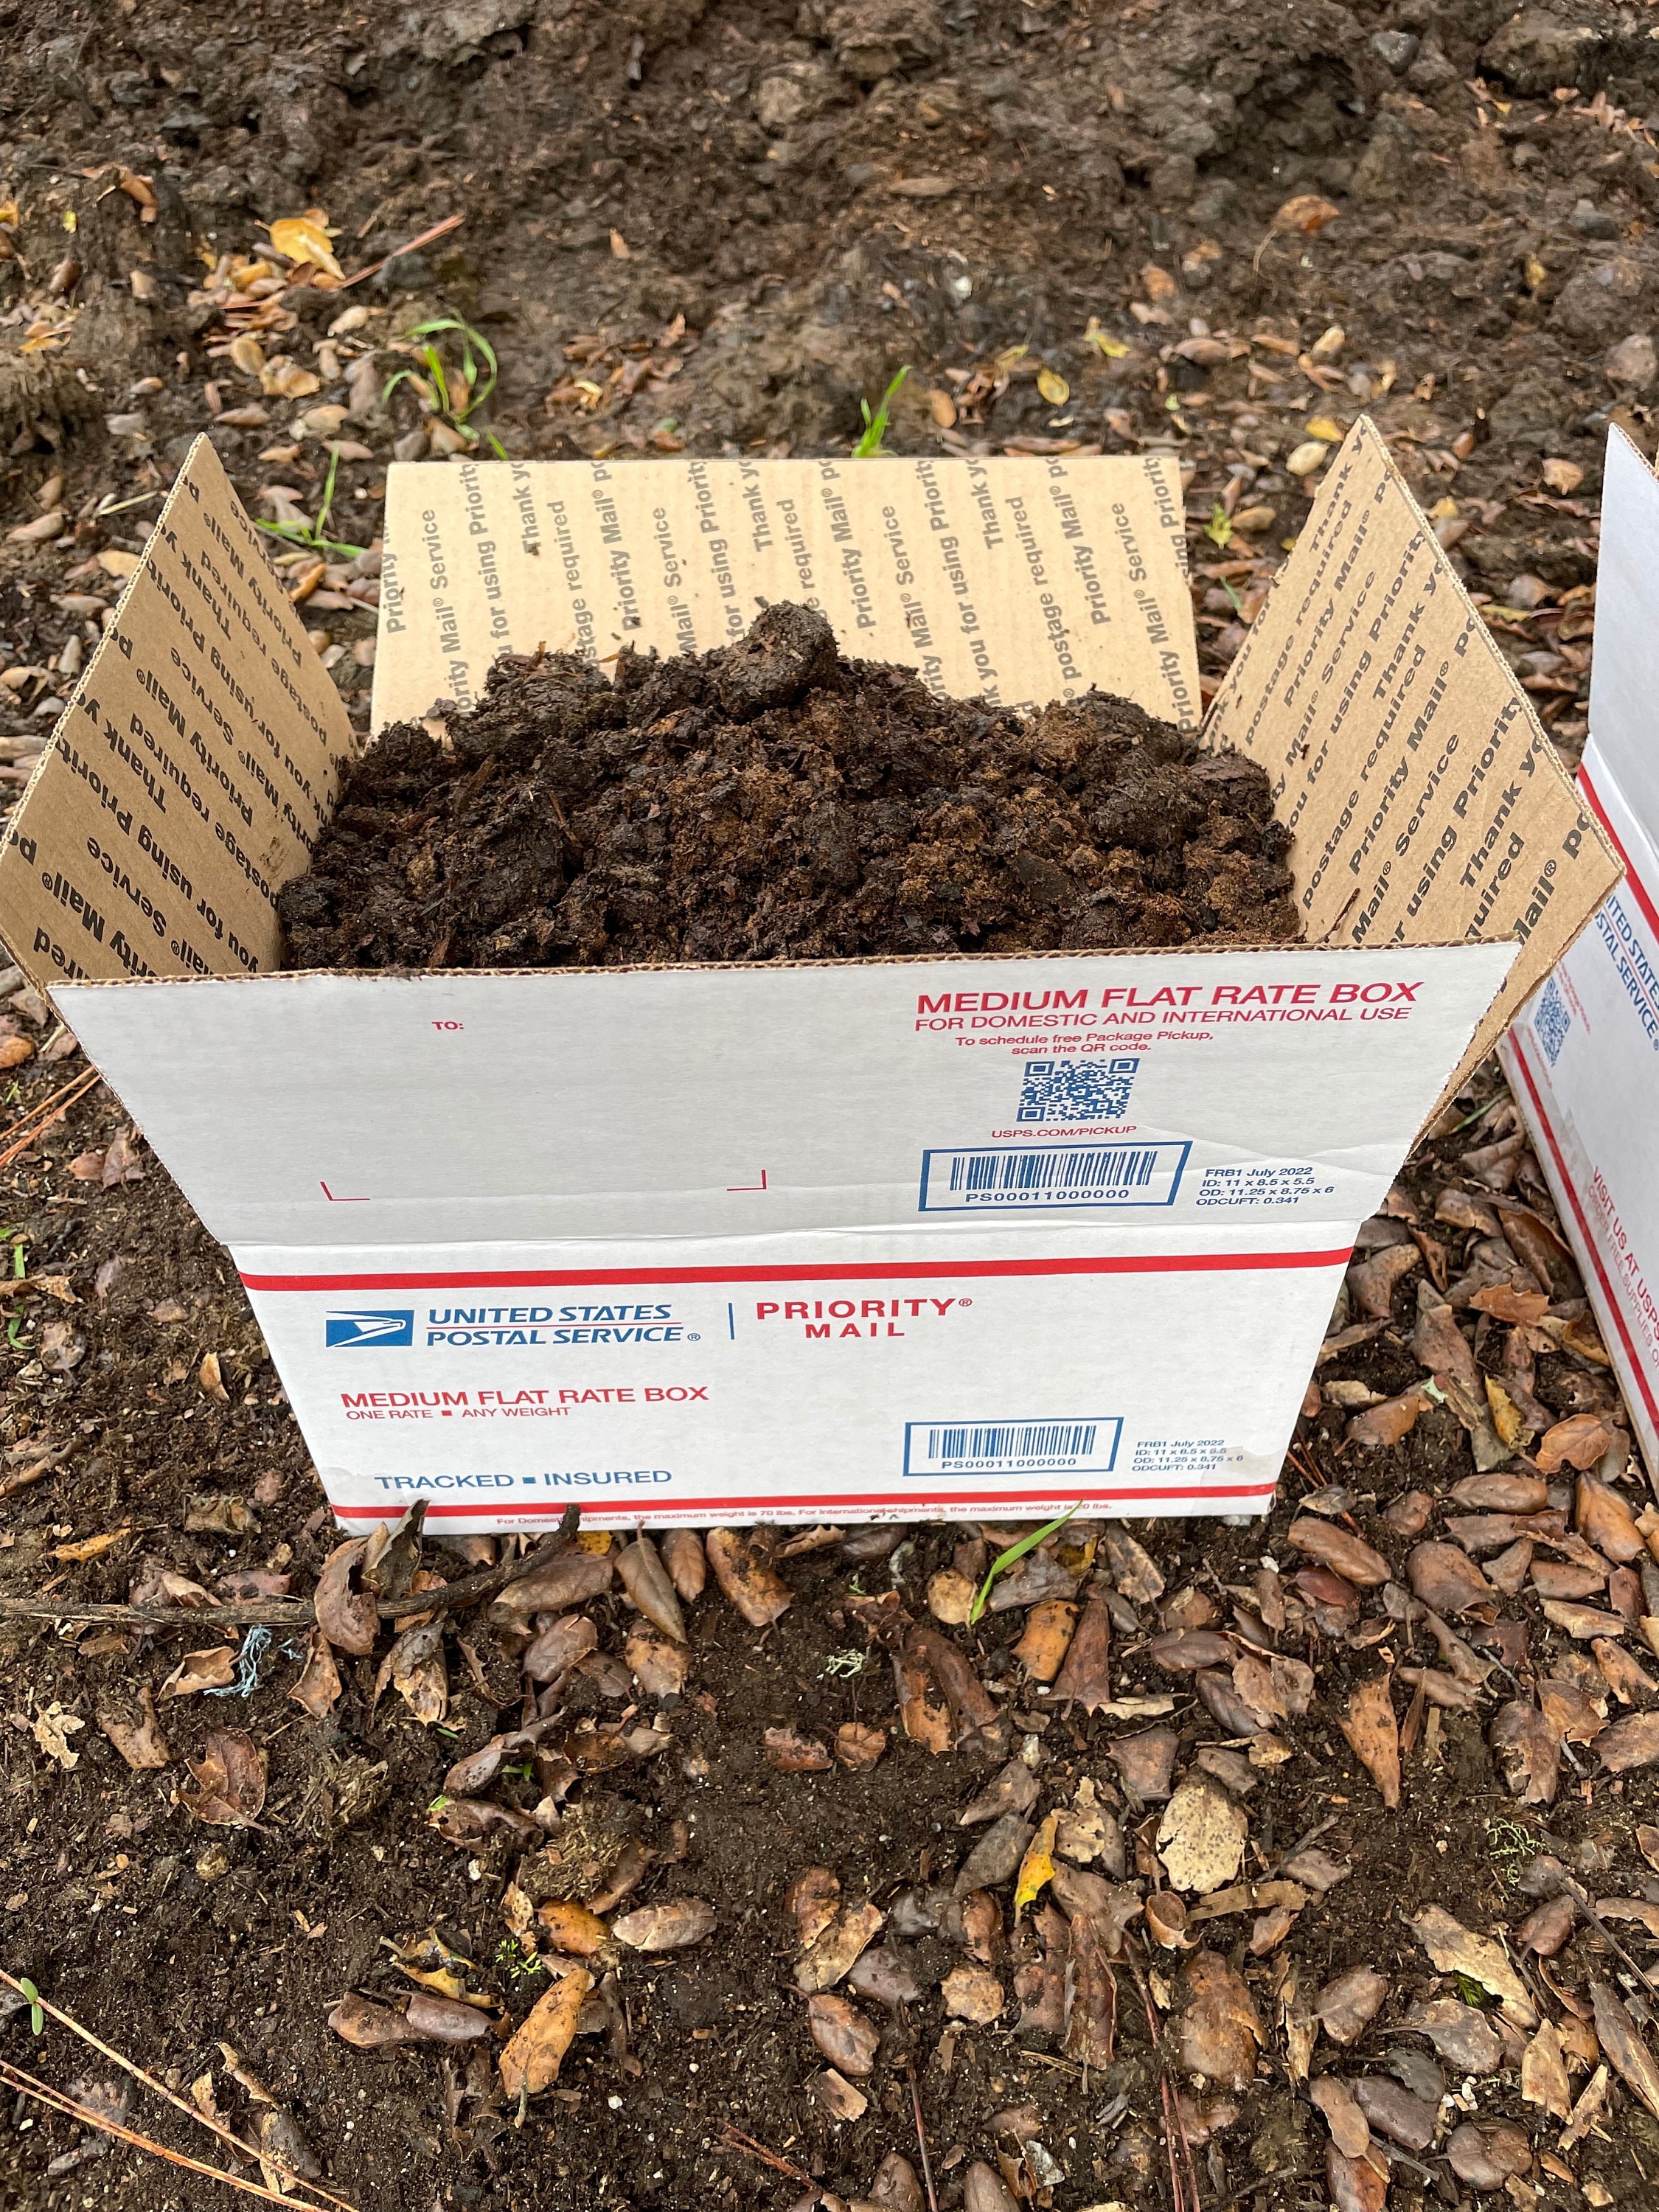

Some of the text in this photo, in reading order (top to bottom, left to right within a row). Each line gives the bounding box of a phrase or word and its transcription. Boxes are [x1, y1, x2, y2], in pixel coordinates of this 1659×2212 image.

[204, 513, 244, 580] Mail®
[547, 501, 582, 591] required
[593, 490, 622, 543] Mail®
[653, 508, 681, 587] Service
[743, 484, 773, 552] Thank
[776, 500, 815, 589] required
[971, 482, 1003, 549] Thank
[1310, 462, 1353, 552] Thank
[180, 552, 231, 641] Thank
[422, 510, 460, 653] Mail® Service
[478, 541, 501, 599] using
[709, 539, 735, 598] using
[822, 488, 876, 628] Priority Mail®
[883, 507, 933, 648] Mail® Service
[940, 537, 968, 595] using
[1005, 497, 1082, 680] postage required
[1050, 486, 1110, 625] Priority Mail®
[1112, 504, 1169, 644] Mail® Service
[201, 550, 266, 656] required
[248, 577, 302, 668] Priority
[490, 607, 509, 639] for
[959, 602, 980, 634] for
[1245, 500, 1352, 745] postage required
[1284, 509, 1369, 708] Priority Mail®
[970, 640, 998, 680] you
[1285, 571, 1375, 768] Mail® Service
[1372, 602, 1425, 699] Thank
[171, 647, 279, 808] Mail® Service
[211, 647, 311, 799] you for using
[271, 658, 327, 747] postage
[1307, 650, 1371, 785] for using
[103, 718, 166, 814] Thank
[130, 712, 209, 823] required
[136, 668, 253, 827] Priority Mail®
[1302, 644, 1426, 910] postage required
[1349, 661, 1449, 876] Priority Mail®
[1352, 734, 1458, 944] Mail® Service
[1406, 825, 1457, 917] using
[1459, 780, 1522, 891] Thank
[42, 871, 105, 944] Mail®
[87, 837, 167, 937] Service
[138, 824, 259, 973] you for using
[432, 1021, 464, 1030] TO:
[916, 1007, 1412, 1031] FOR DOMESTIC AND INTERNATIONAL USE
[918, 982, 1424, 1014] MEDIUM FLAT RATE BOX
[956, 1031, 1213, 1046] To schedule free Package Pickup,
[1053, 1045, 1077, 1053] the
[1081, 1044, 1105, 1052] QR
[1110, 1043, 1151, 1051] code.
[992, 1126, 1136, 1138] USPS.COM/PICKUP
[1247, 1169, 1276, 1178] July
[1279, 1167, 1312, 1175] 2022
[966, 1190, 1129, 1202] PS00011000000
[1593, 1166, 1641, 1277] VISIT US AT
[429, 1304, 671, 1324] UNITED STATES
[806, 1323, 904, 1338] MAIL
[1607, 1234, 1623, 1274] FREE
[1623, 1273, 1653, 1347] SUPPLIES
[427, 1330, 546, 1346] POSTAL
[341, 1387, 709, 1408] MEDIUM FLAT RATE BOX
[347, 1407, 571, 1419] ONE RATE ANY WEIGHT
[375, 1471, 672, 1489] TRACKED INSURED
[942, 1458, 1076, 1469] PS00011000000
